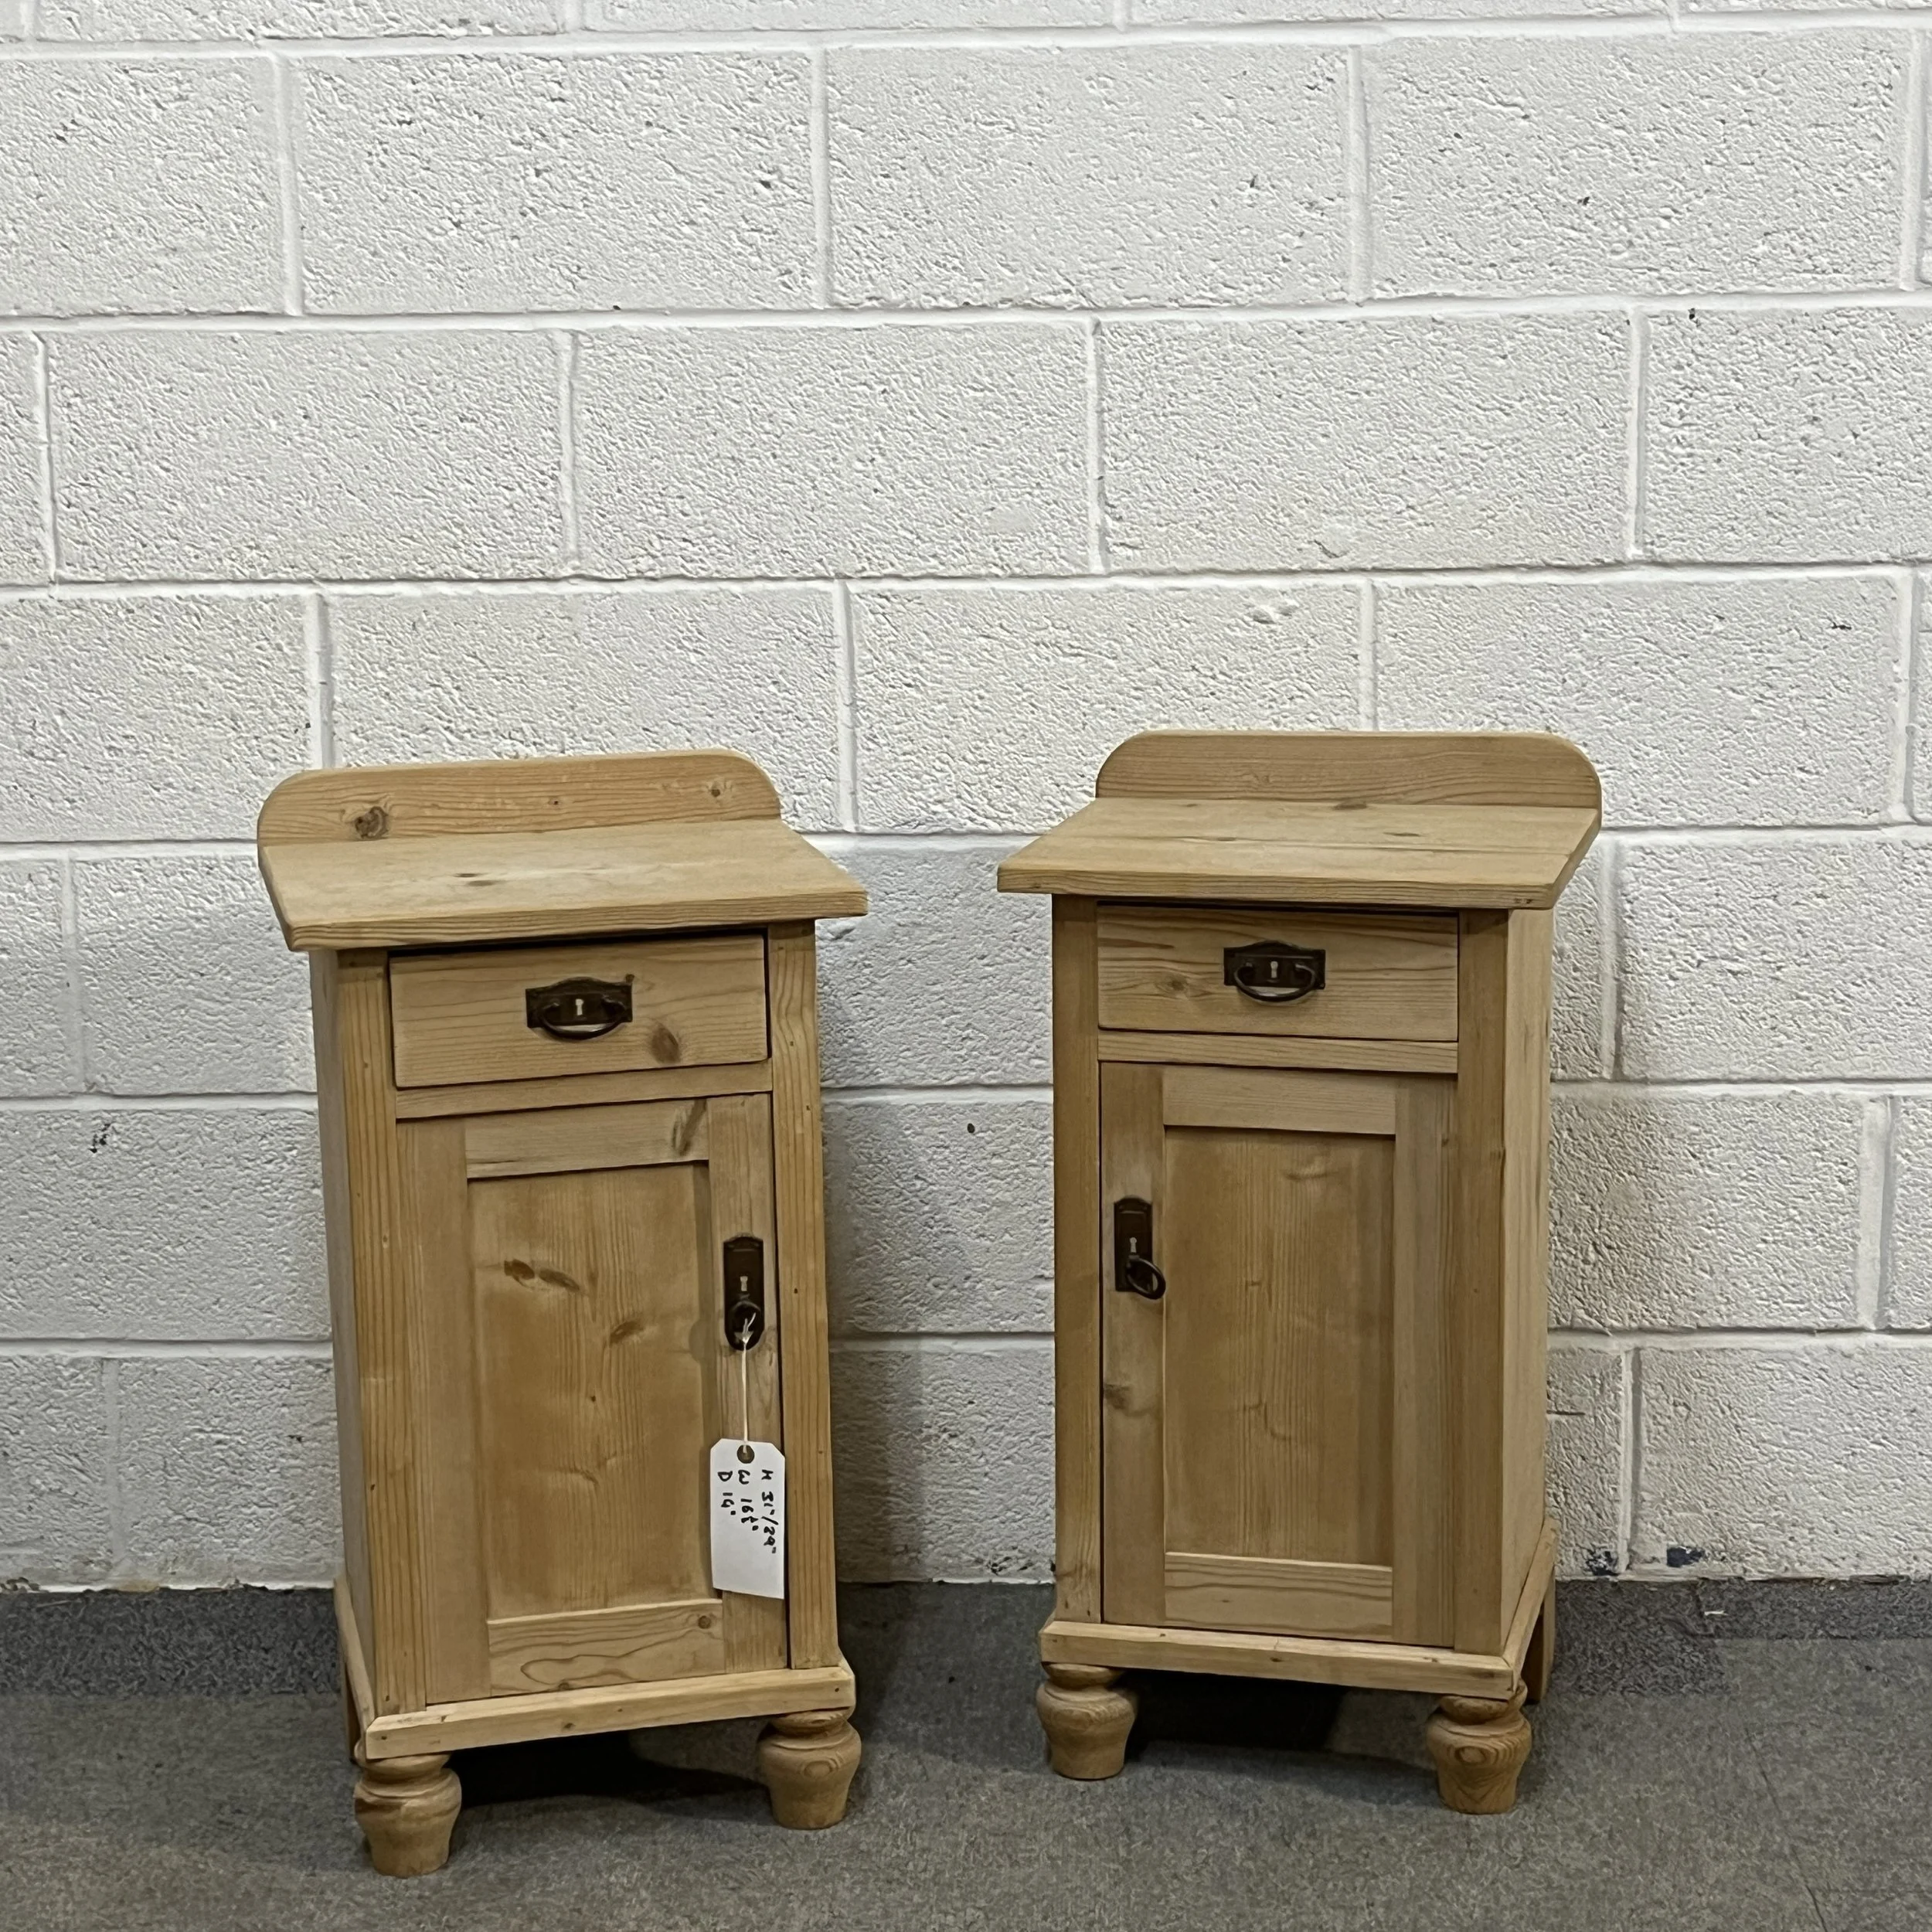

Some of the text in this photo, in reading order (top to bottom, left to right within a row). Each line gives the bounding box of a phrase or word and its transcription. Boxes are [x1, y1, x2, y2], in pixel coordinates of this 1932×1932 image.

[717, 1471, 733, 1482] D
[737, 1469, 751, 1485] W
[761, 1469, 774, 1480] H
